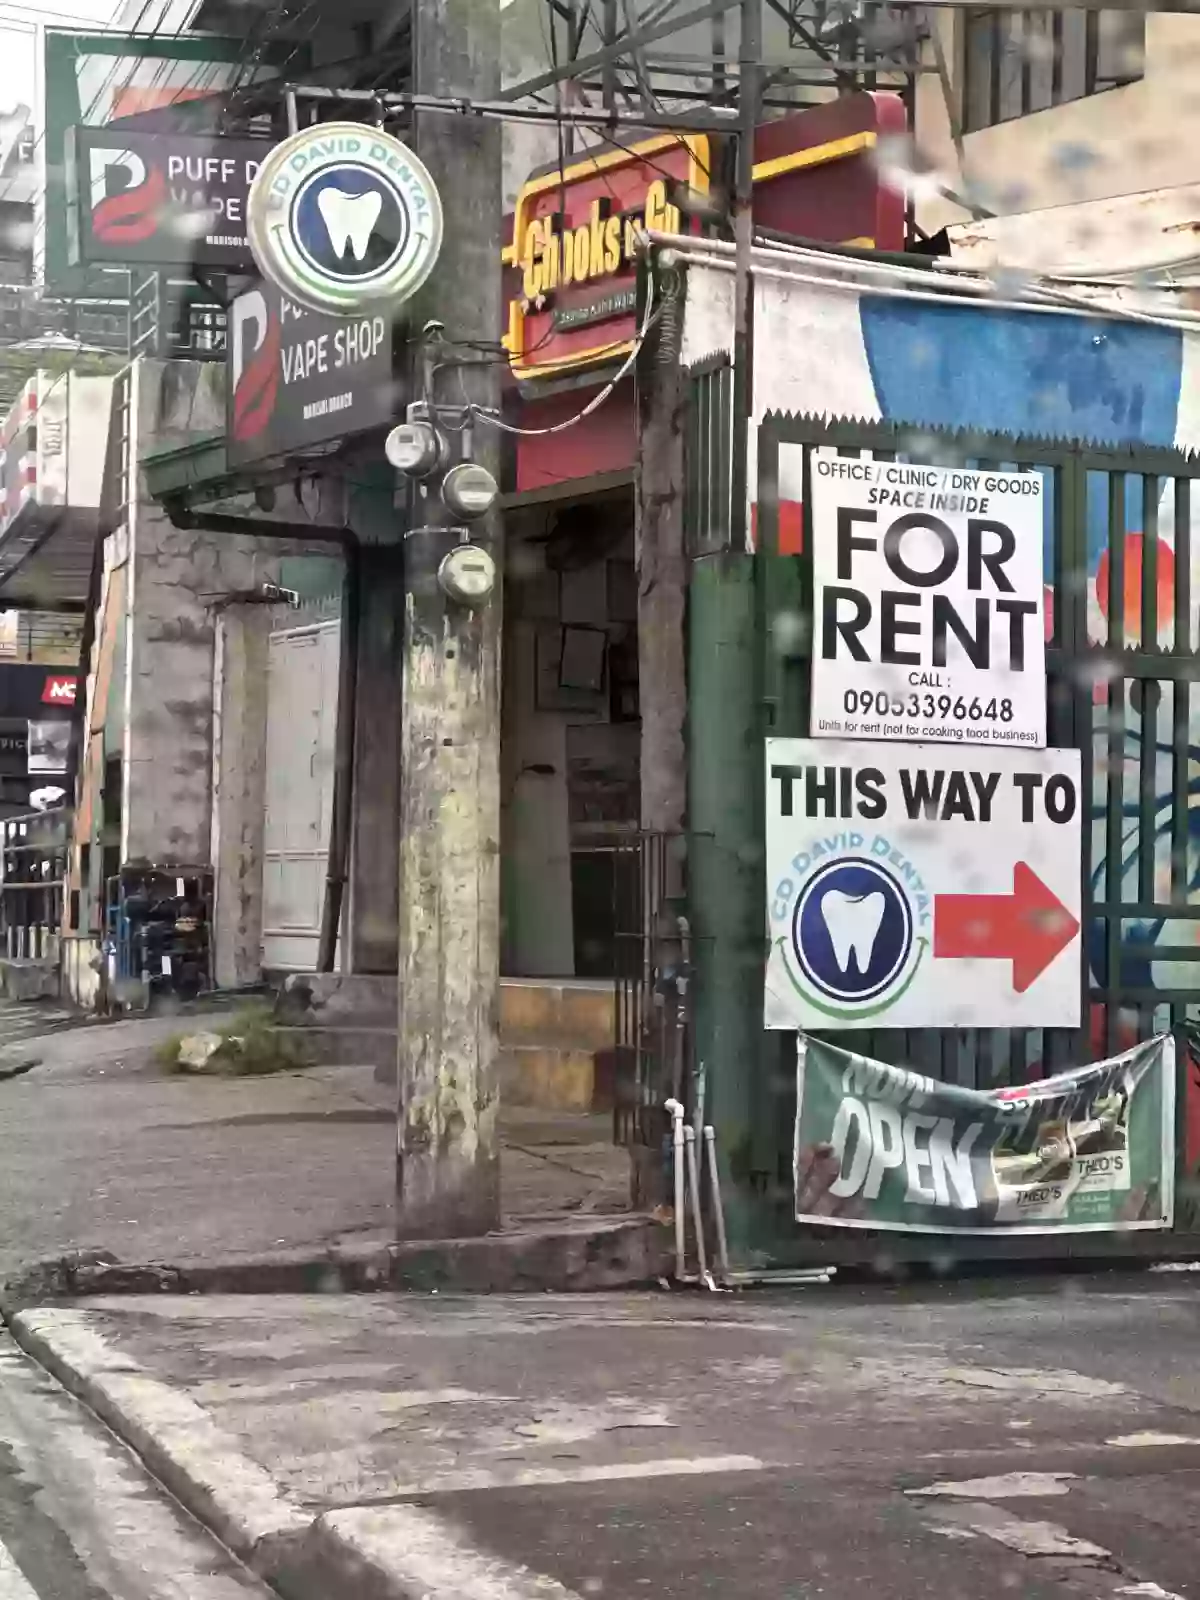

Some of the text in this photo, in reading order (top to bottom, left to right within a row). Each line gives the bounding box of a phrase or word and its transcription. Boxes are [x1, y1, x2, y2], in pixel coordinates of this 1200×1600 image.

[168, 155, 236, 184] PUFF
[290, 138, 361, 173] DAVID
[369, 142, 430, 226] DENTAL
[280, 316, 385, 385] VAPE SHOP
[817, 460, 873, 482] OFFICE
[886, 468, 938, 488] CLINIC
[952, 474, 981, 492] DRY
[985, 477, 1040, 496] GOODS
[868, 487, 989, 514] SPACE INSIDE
[837, 506, 1017, 593] FOR
[821, 585, 1038, 672] RENT
[908, 671, 943, 688] CALL
[844, 720, 858, 732] for
[861, 722, 880, 733] rent
[883, 723, 903, 736] (not
[906, 723, 919, 735] for
[922, 725, 964, 740] cooking
[966, 726, 990, 739] food
[992, 726, 1038, 743] business)
[771, 764, 1076, 824] THIS WAY TO
[769, 830, 931, 927] CD DAVID DENTAL
[829, 1096, 983, 1210] OPEN
